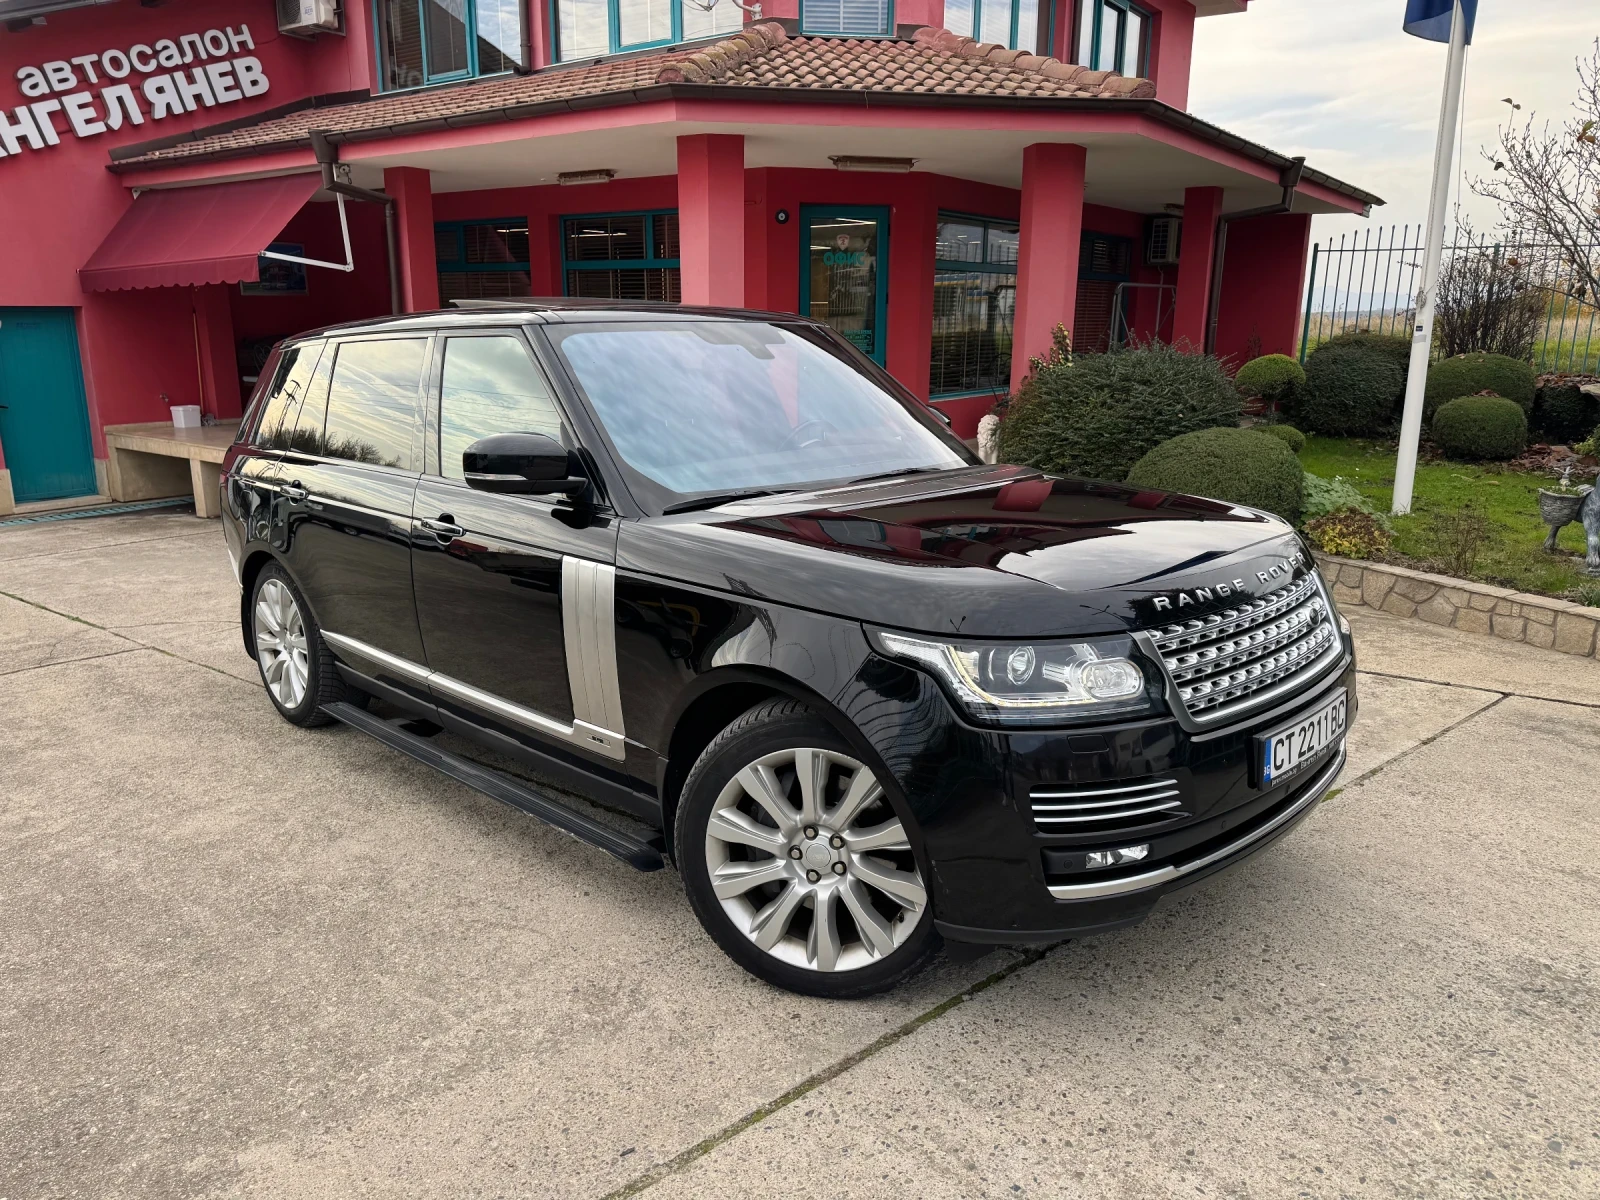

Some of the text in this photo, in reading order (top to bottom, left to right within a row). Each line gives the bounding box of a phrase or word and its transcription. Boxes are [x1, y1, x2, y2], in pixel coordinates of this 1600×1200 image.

[16, 24, 255, 97] автосалон
[0, 56, 269, 158] НГЕЛ ЯНЕВ
[823, 252, 865, 266] ОФИС
[1153, 551, 1306, 611] RANGE ROVER
[1273, 731, 1295, 771] CT
[1298, 711, 1328, 759] 2211
[1331, 699, 1345, 736] BC
